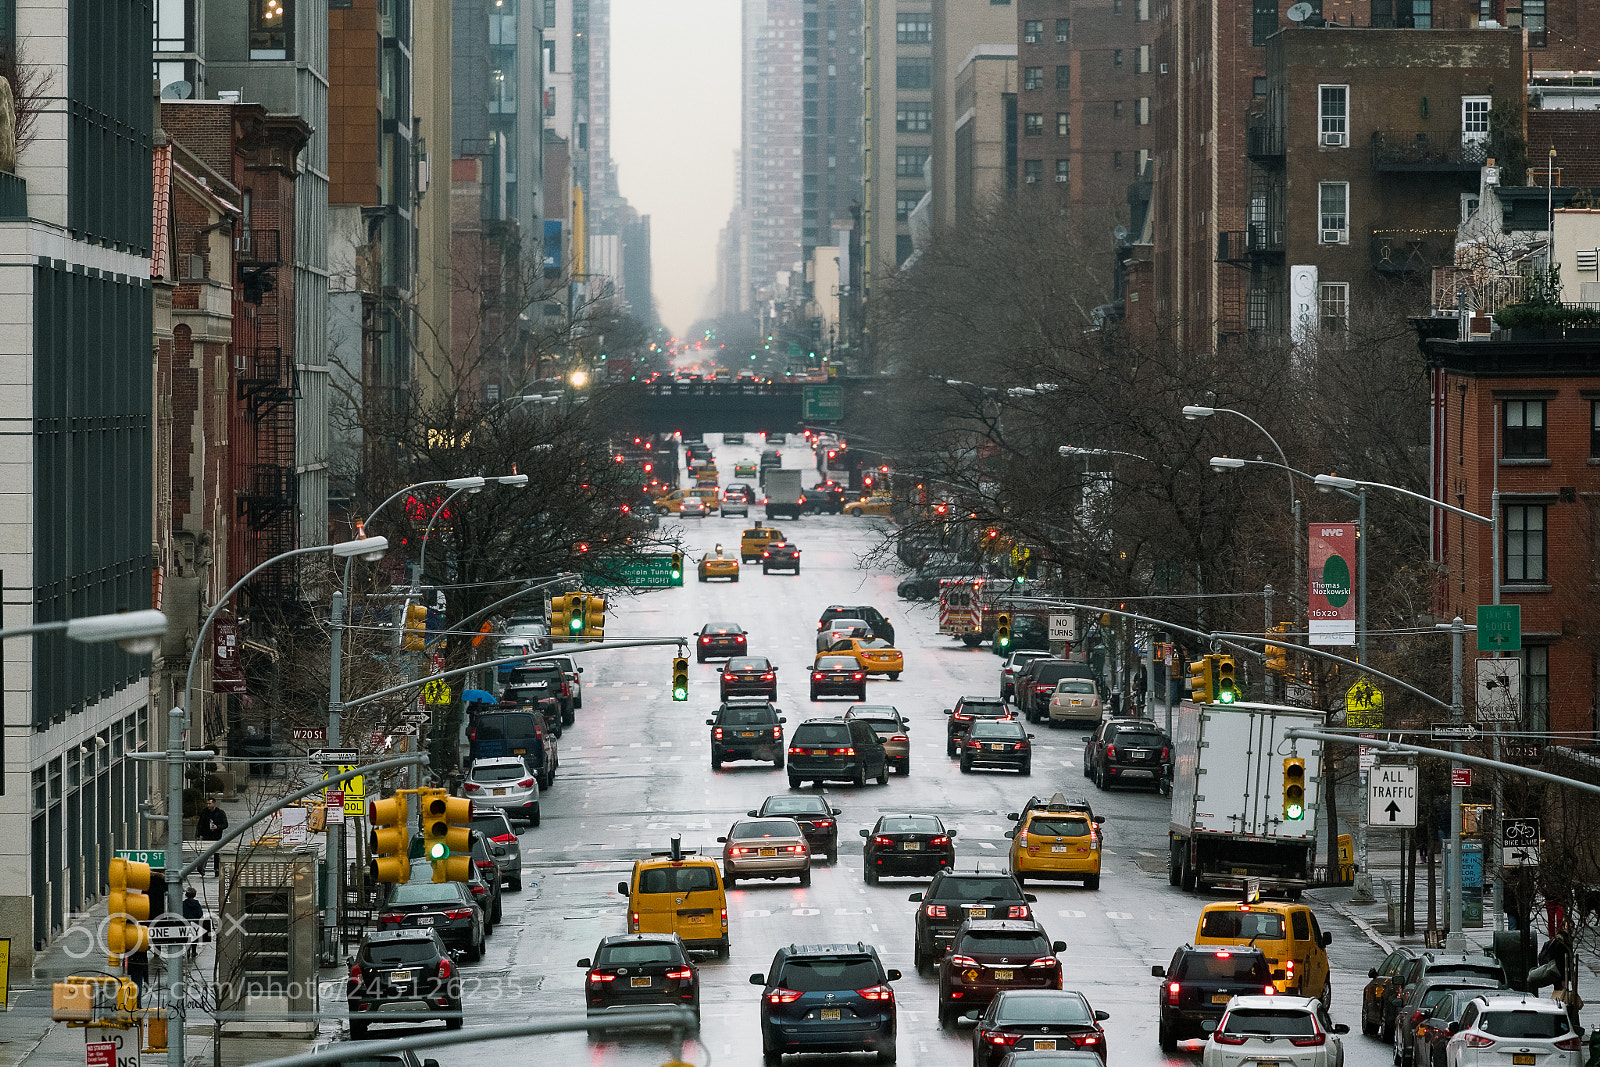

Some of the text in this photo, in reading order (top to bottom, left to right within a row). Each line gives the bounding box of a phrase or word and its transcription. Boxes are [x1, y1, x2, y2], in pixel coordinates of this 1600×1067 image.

[1321, 528, 1344, 537] NYC
[1311, 581, 1341, 589] Thomas
[1312, 608, 1338, 617] 16x20
[1055, 618, 1068, 627] NO
[1050, 628, 1074, 637] TURNS
[293, 730, 323, 739] W 20 St
[1528, 747, 1538, 757] St
[1382, 770, 1404, 783] ALL
[1373, 785, 1414, 799] TRAFFIC
[120, 852, 162, 864] W 19 ST
[148, 927, 200, 938] ONE WAY
